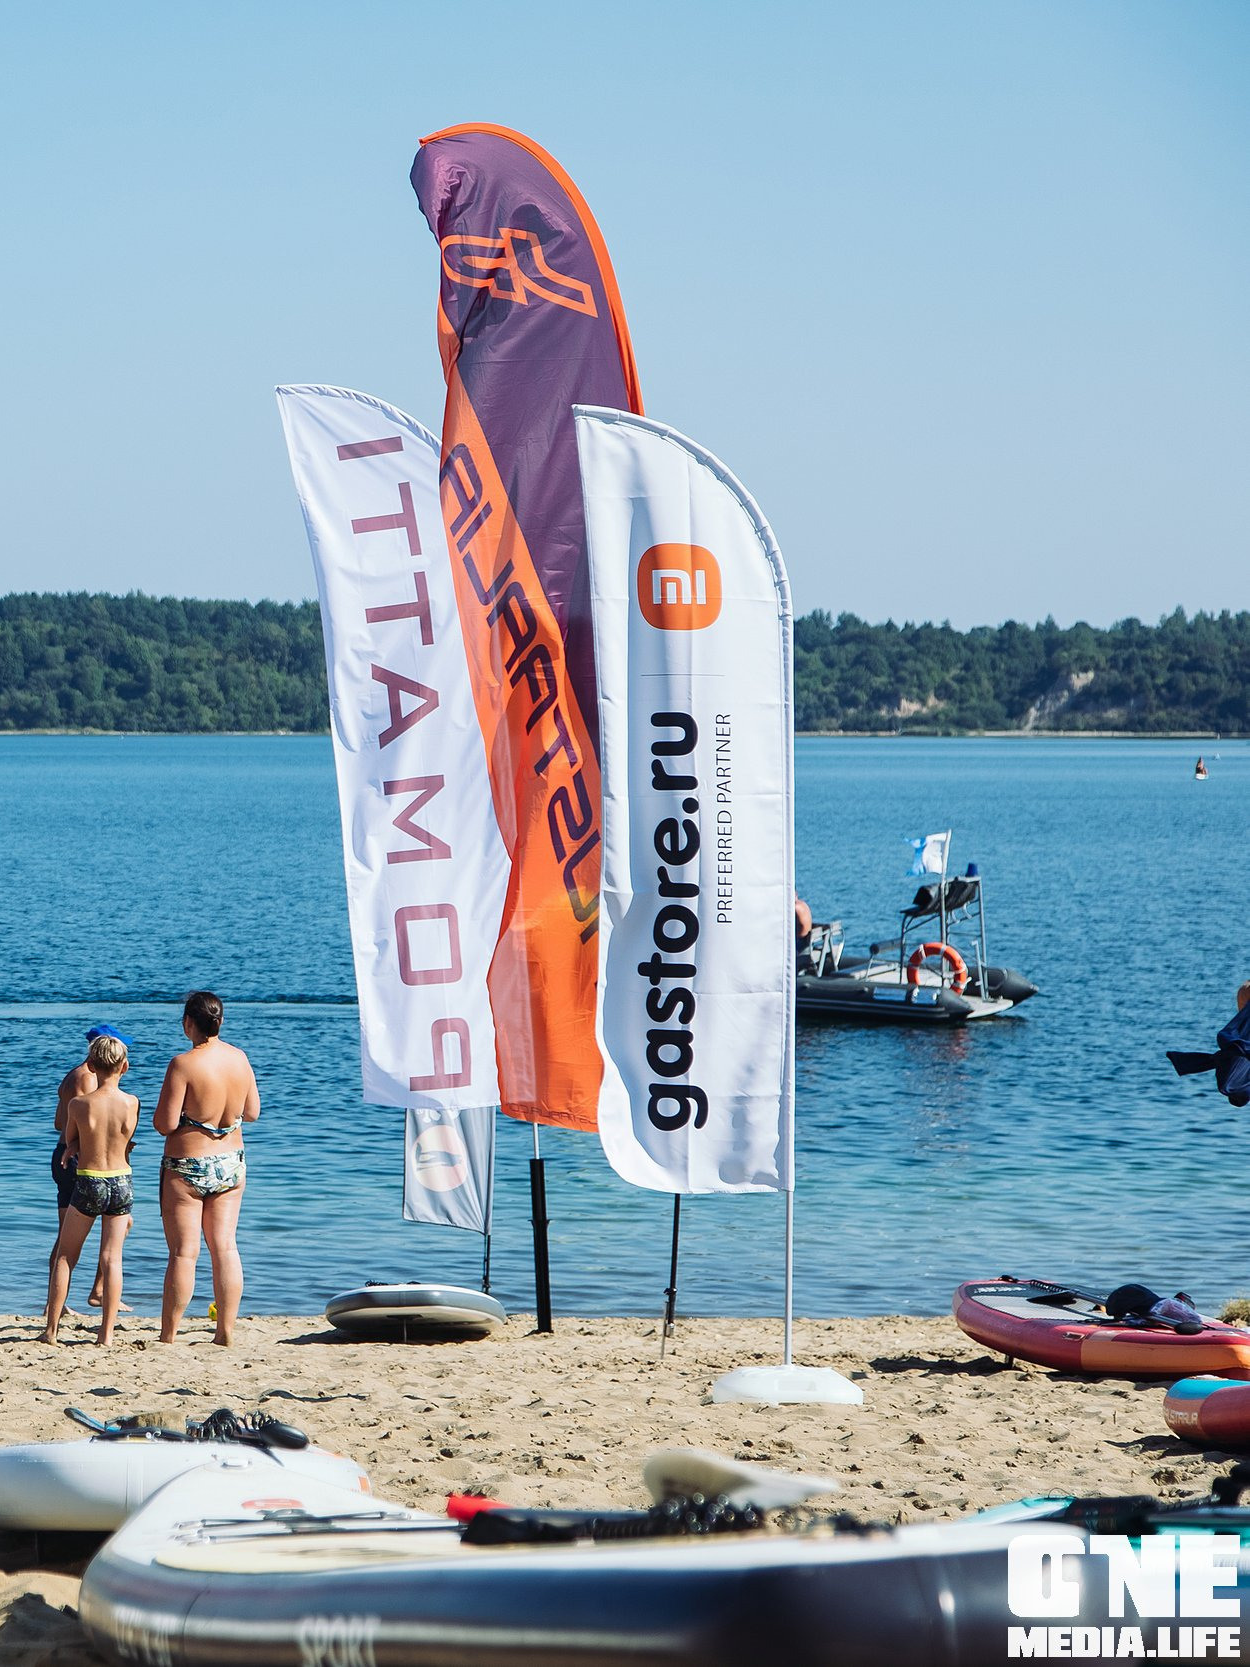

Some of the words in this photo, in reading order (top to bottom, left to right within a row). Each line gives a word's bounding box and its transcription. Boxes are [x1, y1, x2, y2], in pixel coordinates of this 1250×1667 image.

[715, 713, 732, 803] PARTNER
[637, 711, 709, 1132] gastore.ru
[716, 810, 733, 924] PREFERRED
